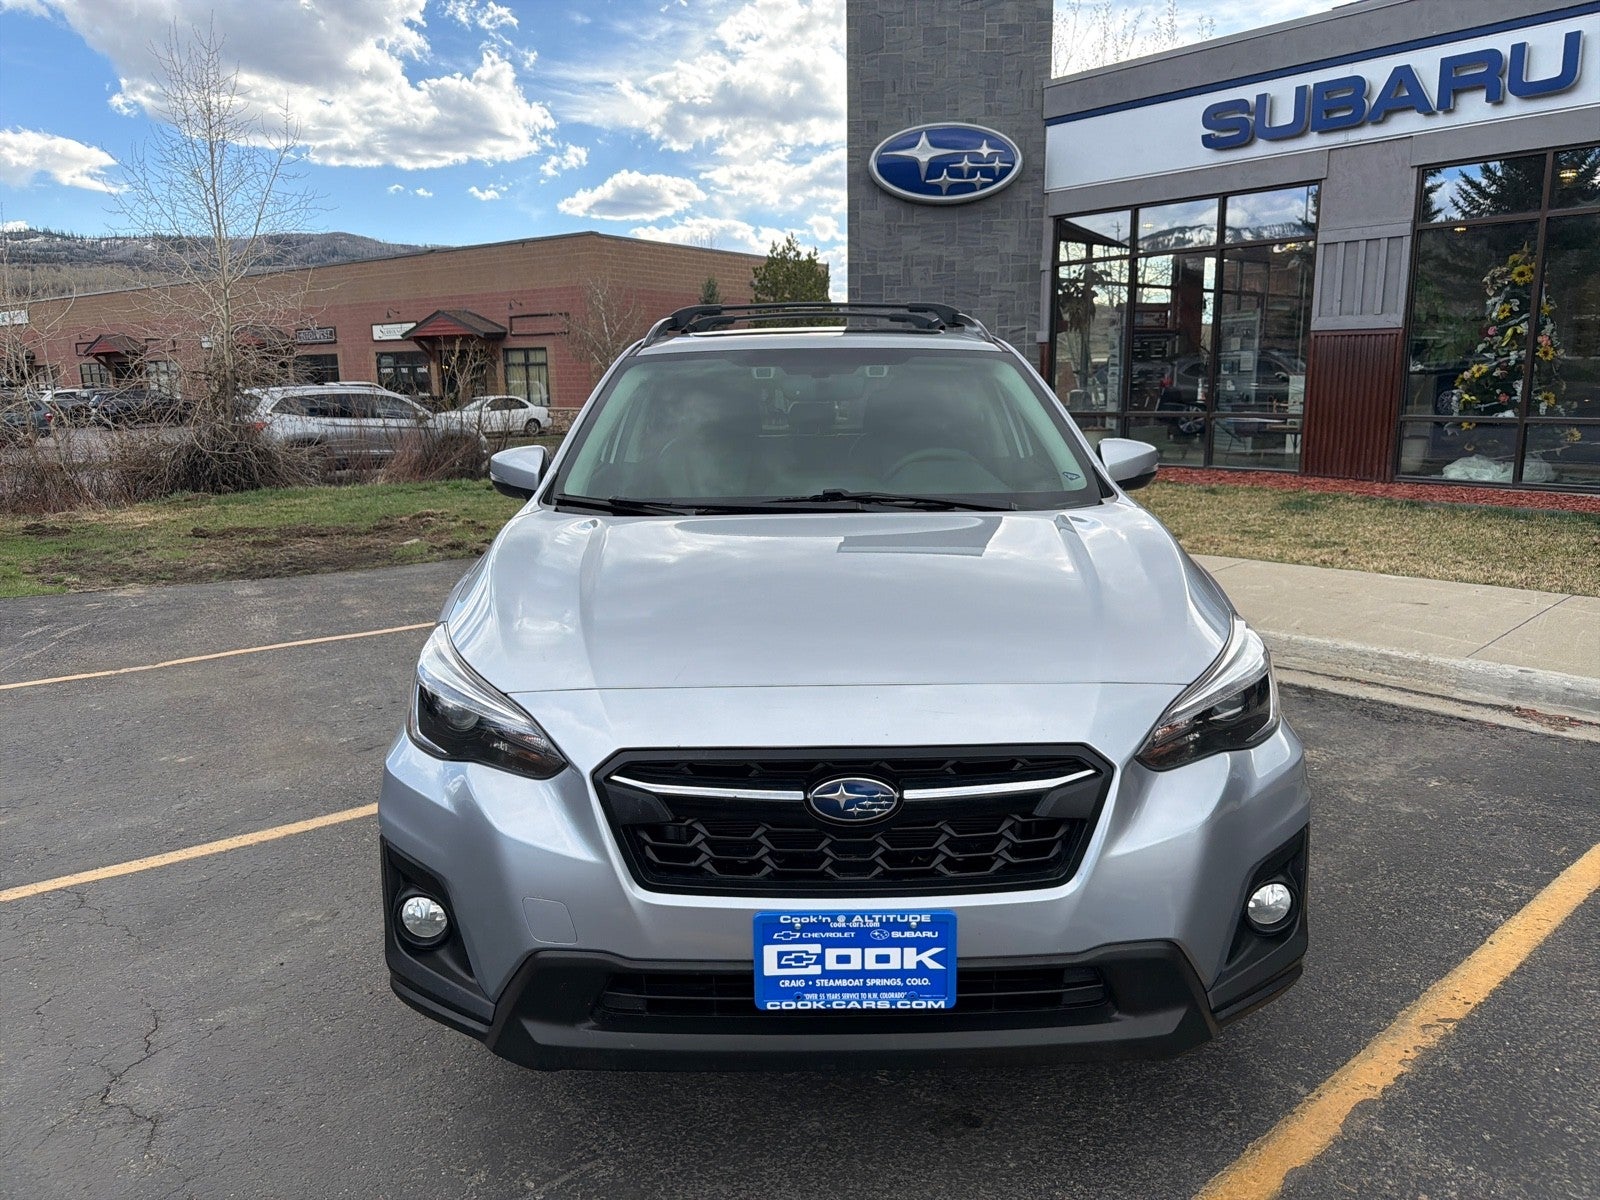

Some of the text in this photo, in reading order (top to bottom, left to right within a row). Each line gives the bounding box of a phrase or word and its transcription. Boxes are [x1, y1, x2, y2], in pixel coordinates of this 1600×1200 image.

[1201, 30, 1582, 149] SUBARU
[779, 915, 831, 923] Cook'n
[852, 914, 931, 922] ALTITUDE
[779, 978, 931, 987] CRAIG STEAMBOAT SPRINGS, COLO.
[766, 1000, 946, 1010] COOK-CARS.COM
